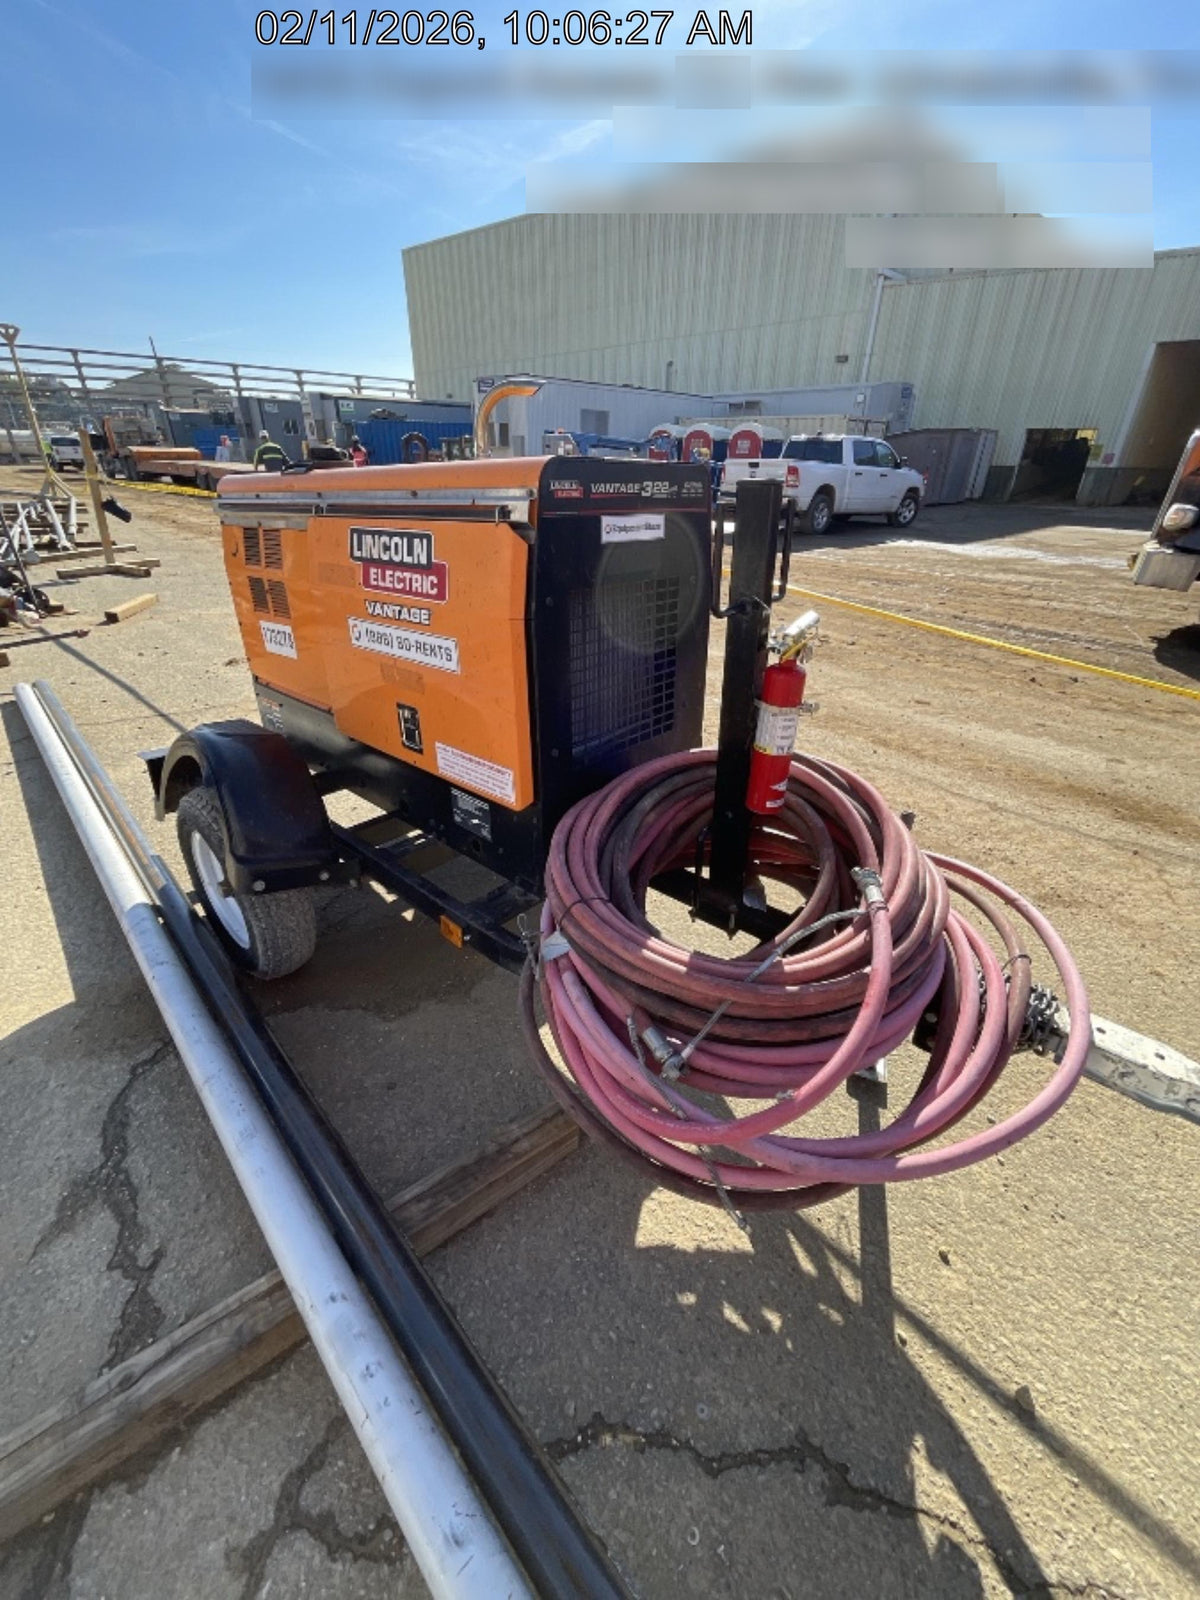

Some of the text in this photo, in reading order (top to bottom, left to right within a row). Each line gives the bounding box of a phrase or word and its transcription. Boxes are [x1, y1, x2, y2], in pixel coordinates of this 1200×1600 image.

[590, 483, 641, 494] VANTAGE
[612, 522, 662, 534] EquipmeShare
[353, 532, 428, 565] LINCOLN
[369, 567, 438, 595] ELECTRIC
[365, 600, 432, 625] VANTAGE
